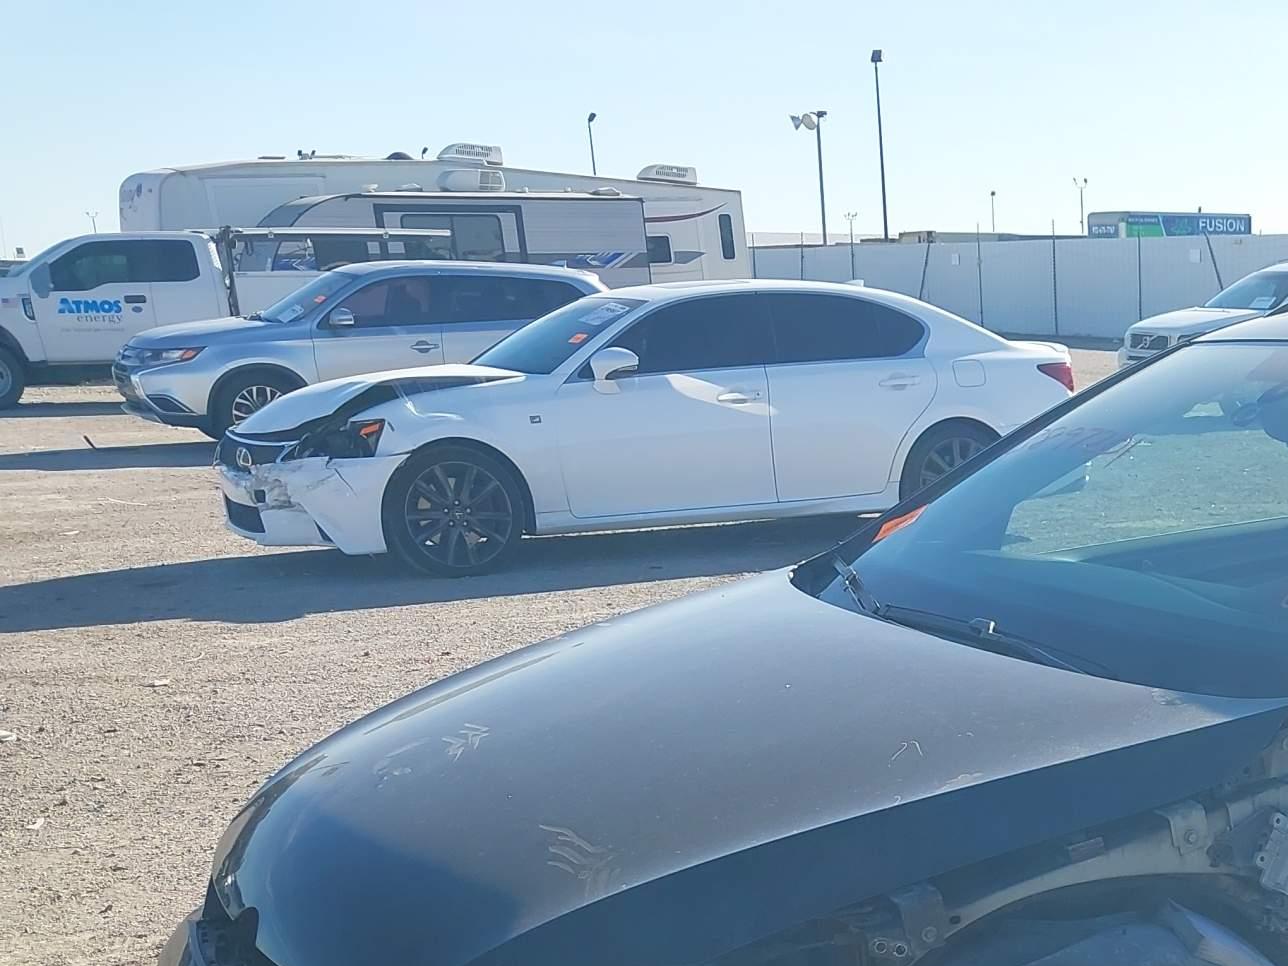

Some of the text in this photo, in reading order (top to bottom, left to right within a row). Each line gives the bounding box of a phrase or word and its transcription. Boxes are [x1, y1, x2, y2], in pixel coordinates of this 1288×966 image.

[1199, 219, 1245, 231] FUSION
[58, 297, 123, 314] ATMOS
[77, 315, 123, 324] energy
